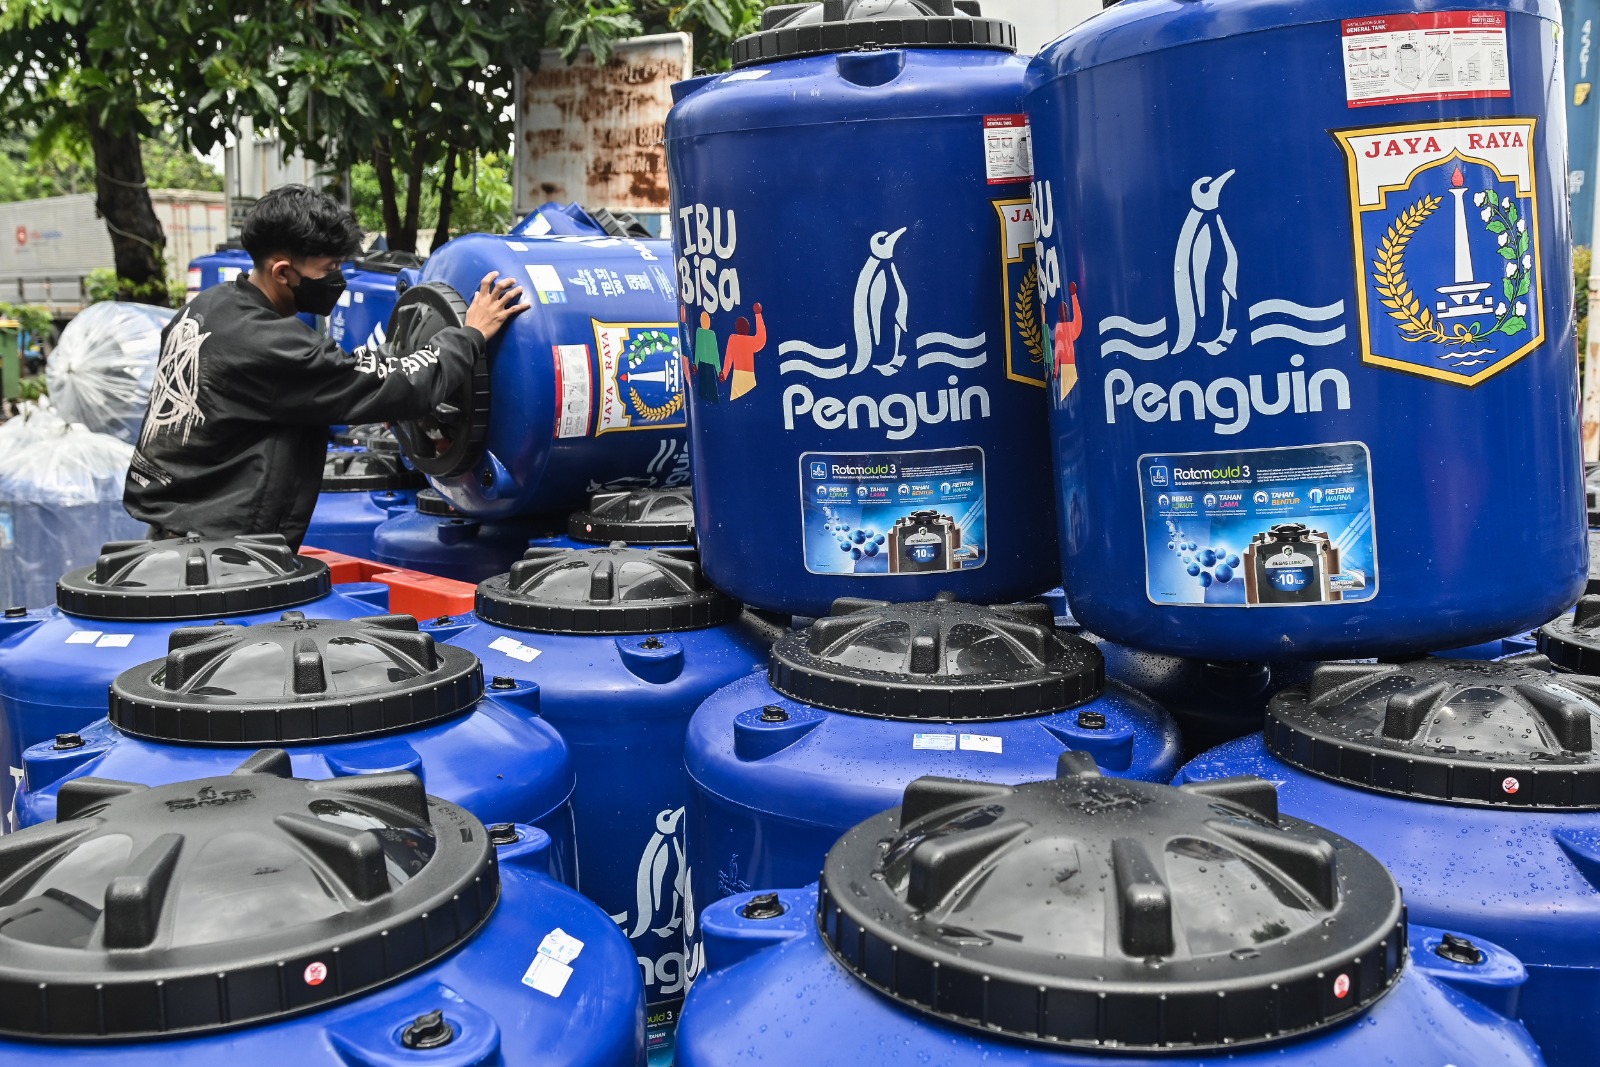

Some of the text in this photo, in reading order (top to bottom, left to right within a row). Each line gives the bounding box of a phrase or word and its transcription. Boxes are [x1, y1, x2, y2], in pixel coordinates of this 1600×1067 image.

[1365, 131, 1524, 159] JAYA RAYA
[1011, 208, 1035, 223] JA
[679, 203, 737, 260] IBU
[601, 332, 614, 425] JAYA RAYA
[1104, 353, 1351, 435] Penguin
[783, 375, 991, 440] Penguin
[831, 464, 889, 475] Rotamould
[889, 464, 896, 474] 3
[1173, 465, 1241, 480] Rotamould
[1242, 465, 1251, 478] 3
[1271, 491, 1295, 499] TAHAN
[1325, 486, 1355, 495] RETENSI
[1325, 494, 1352, 502] WARNA
[1271, 497, 1300, 506] BENTUR
[648, 1032, 666, 1040] TAHAN
